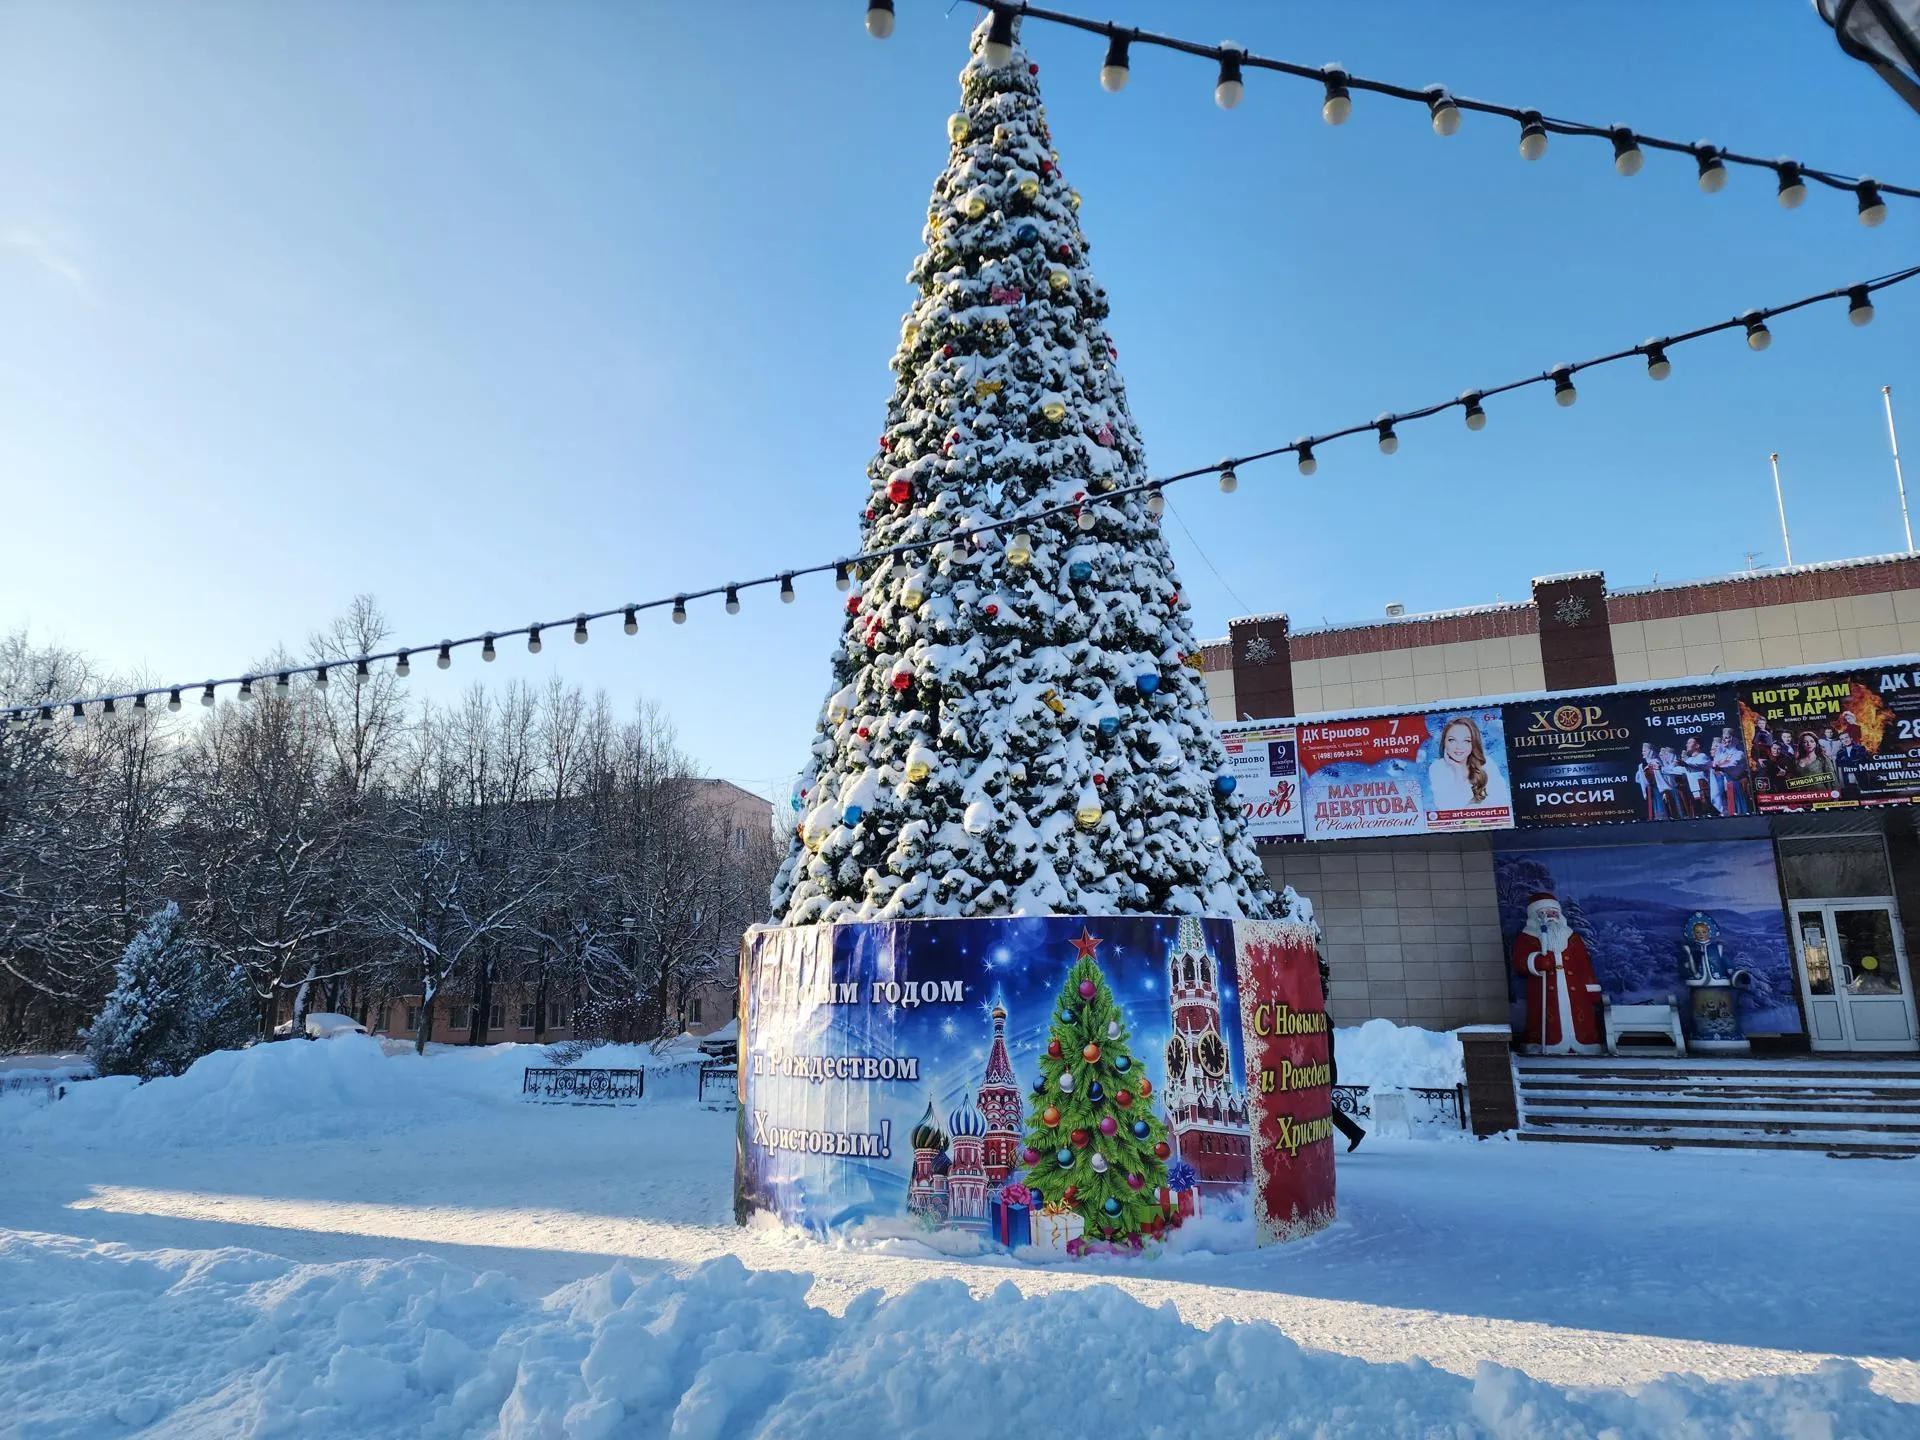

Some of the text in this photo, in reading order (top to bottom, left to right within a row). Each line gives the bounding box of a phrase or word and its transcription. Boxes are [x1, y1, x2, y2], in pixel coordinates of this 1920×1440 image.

[1880, 673, 1909, 693] ДК
[1649, 693, 1716, 706] ДОМ КУЛЬТУРЫ
[1752, 683, 1850, 705] НОТР ДАМ
[1677, 701, 1715, 710] ЕРШОВО
[1767, 708, 1784, 720] ДЕ
[1789, 700, 1841, 717] ПАРИ
[1527, 705, 1609, 732] ХОР
[1645, 712, 1726, 727] 16 ДЕКАБРЯ
[1302, 726, 1370, 744] ДК Ершово
[1389, 719, 1399, 736] 7
[1674, 725, 1703, 735] 18:00
[1373, 734, 1420, 748] ЯНВАРЯ
[1514, 727, 1630, 748] ПЯТНИЦКОГО
[1277, 745, 1286, 759] 9
[1317, 751, 1333, 760] (498)
[1333, 749, 1363, 759] 690-84-25
[1390, 747, 1409, 755] 18:00
[1908, 748, 1920, 758] С
[1859, 761, 1902, 772] МАРКИН
[1519, 775, 1628, 789] НАМ НУЖНА ВЕЛИКАЯ
[1757, 779, 1768, 789] 6+
[1789, 774, 1831, 787] ЖИВОЙ ЗВУК
[1327, 781, 1399, 800] МАРИНА
[1535, 789, 1615, 806] РОССИЯ
[1774, 792, 1829, 801] art-concert.ru
[1314, 795, 1418, 821] ДЕВЯТОВА
[1451, 808, 1508, 818] art-concert.ru
[1327, 814, 1419, 831] Рождеством!
[872, 980, 964, 1009] годом
[1254, 1003, 1270, 1037] С
[1275, 1004, 1319, 1036] Новым
[754, 1044, 919, 1084] и Рождеством
[1261, 1069, 1275, 1093] и
[753, 1109, 892, 1158] Христовым!
